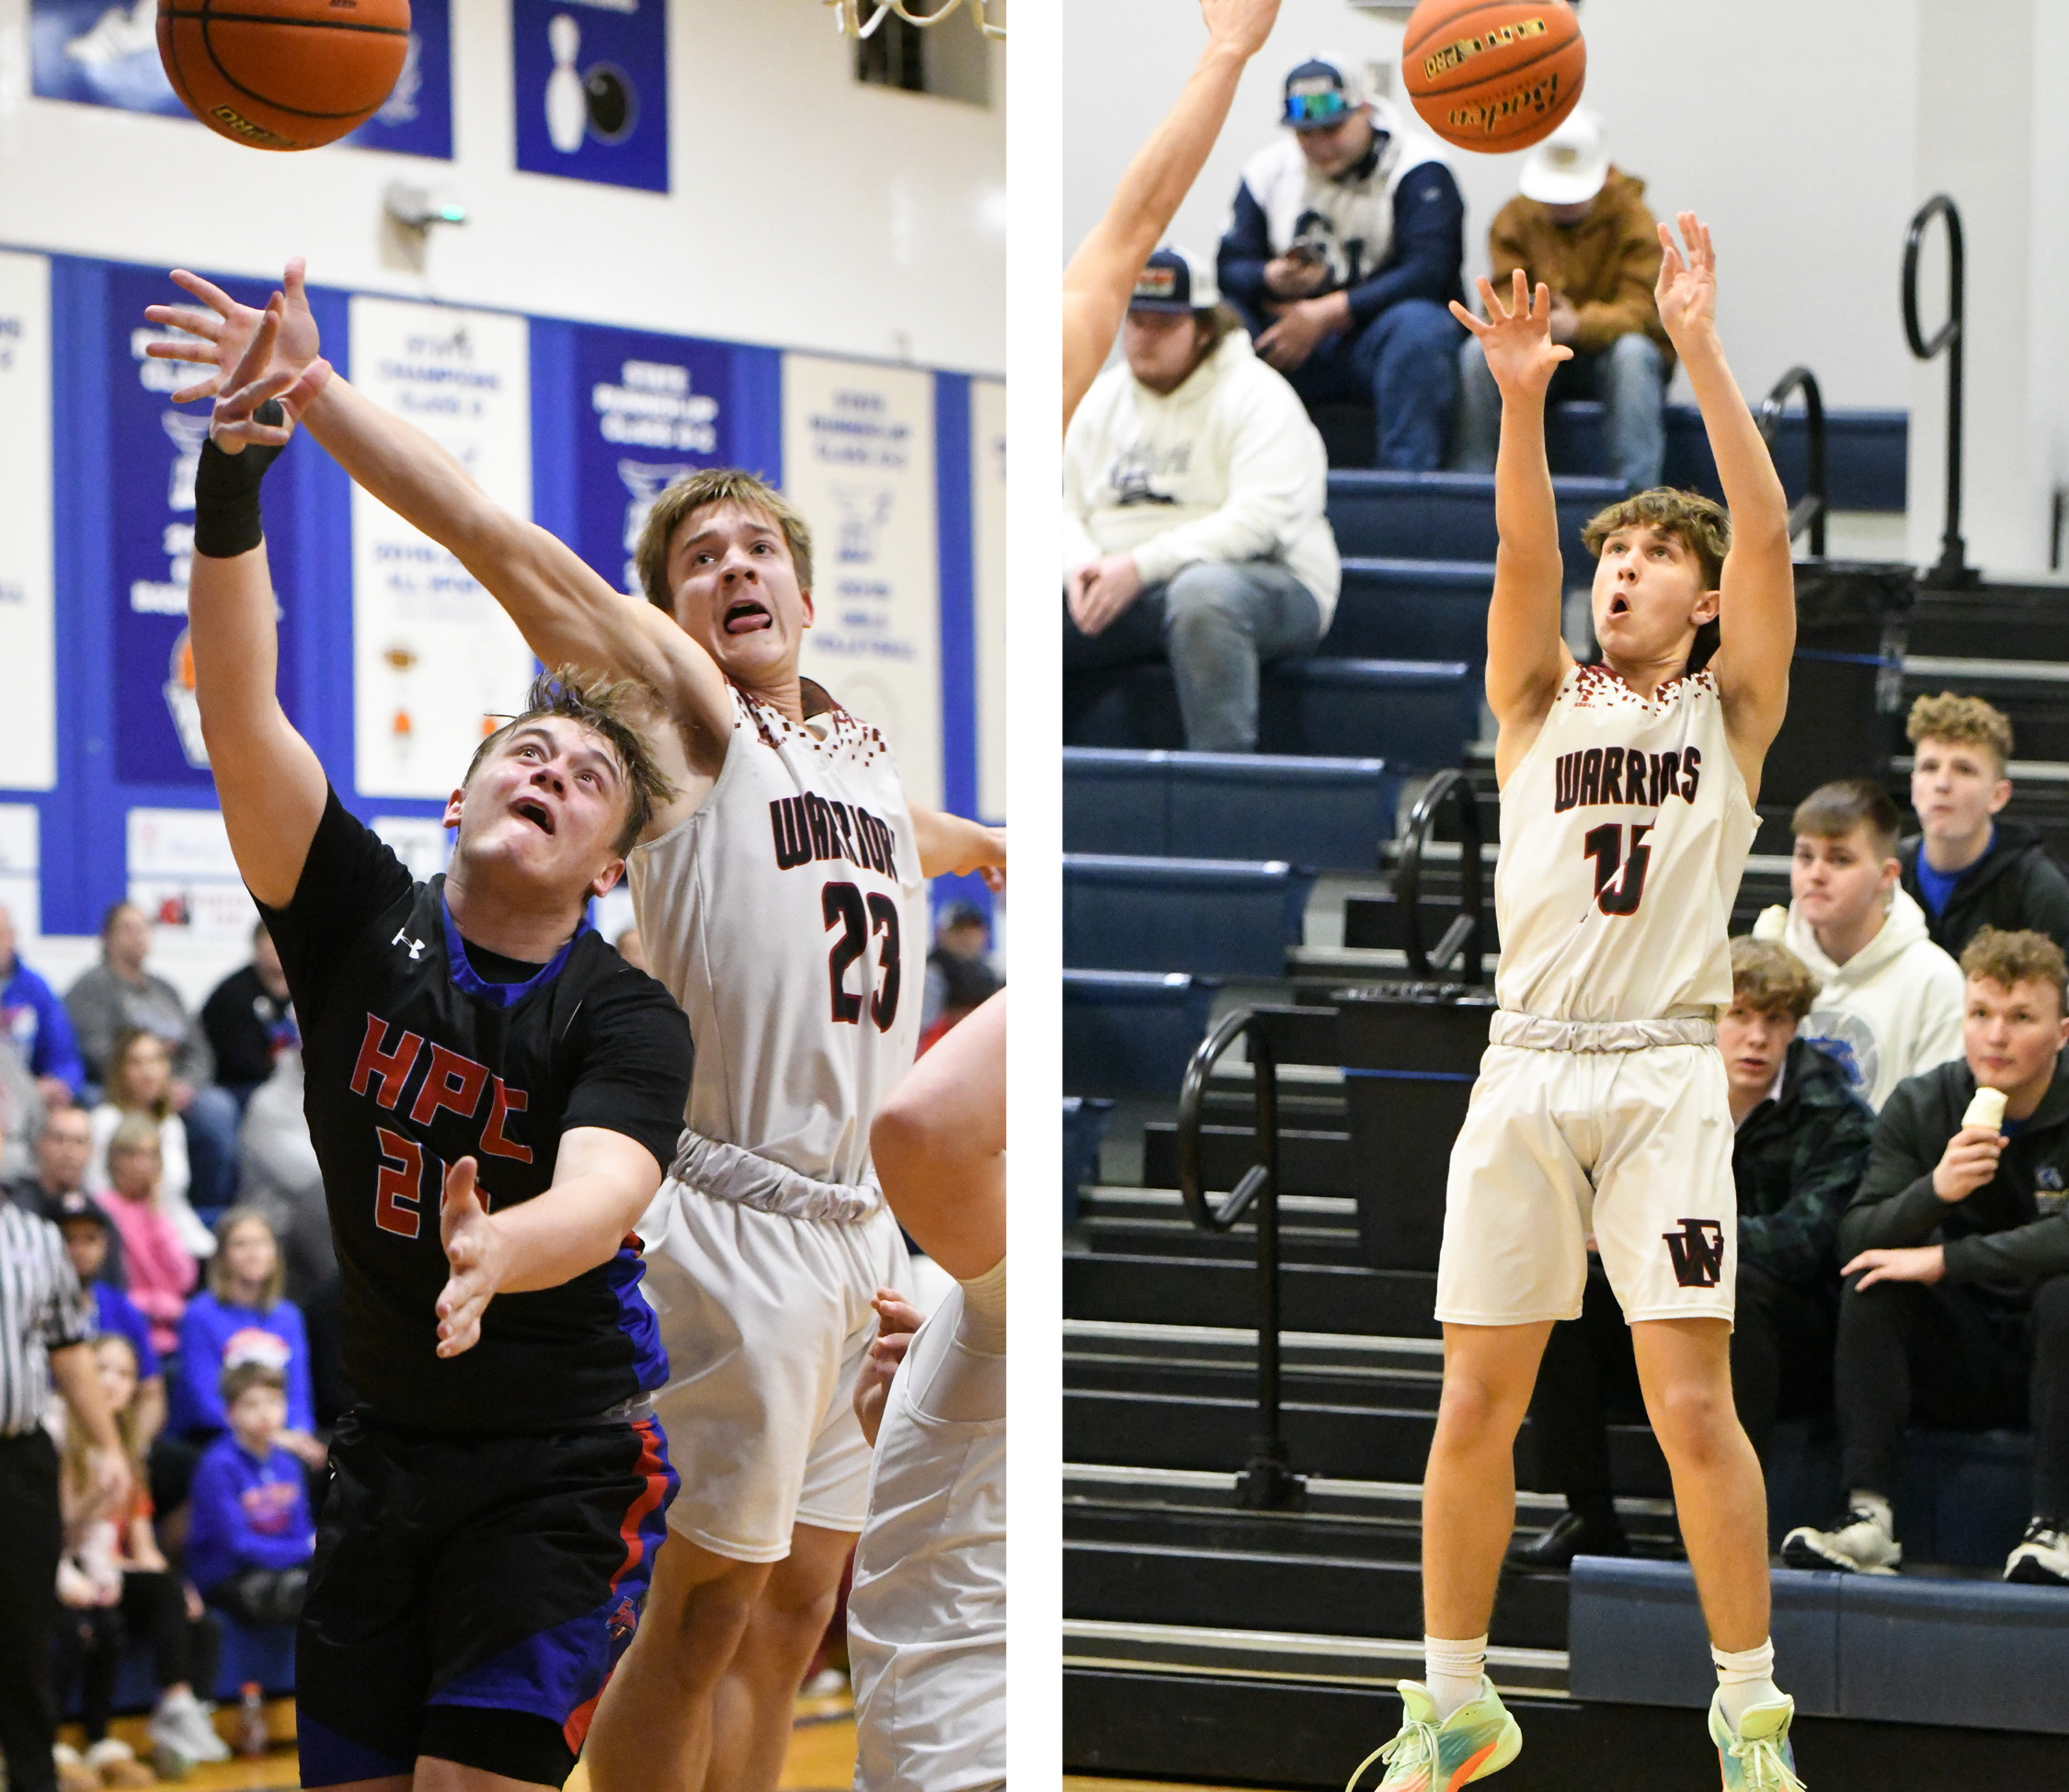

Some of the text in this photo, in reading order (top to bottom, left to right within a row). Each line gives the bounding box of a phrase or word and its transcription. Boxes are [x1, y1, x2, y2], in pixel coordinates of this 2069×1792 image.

[769, 791, 897, 883] WARRIOR
[821, 881, 901, 1033] 23
[349, 1011, 532, 1164] HPC
[375, 1125, 491, 1238] 2
